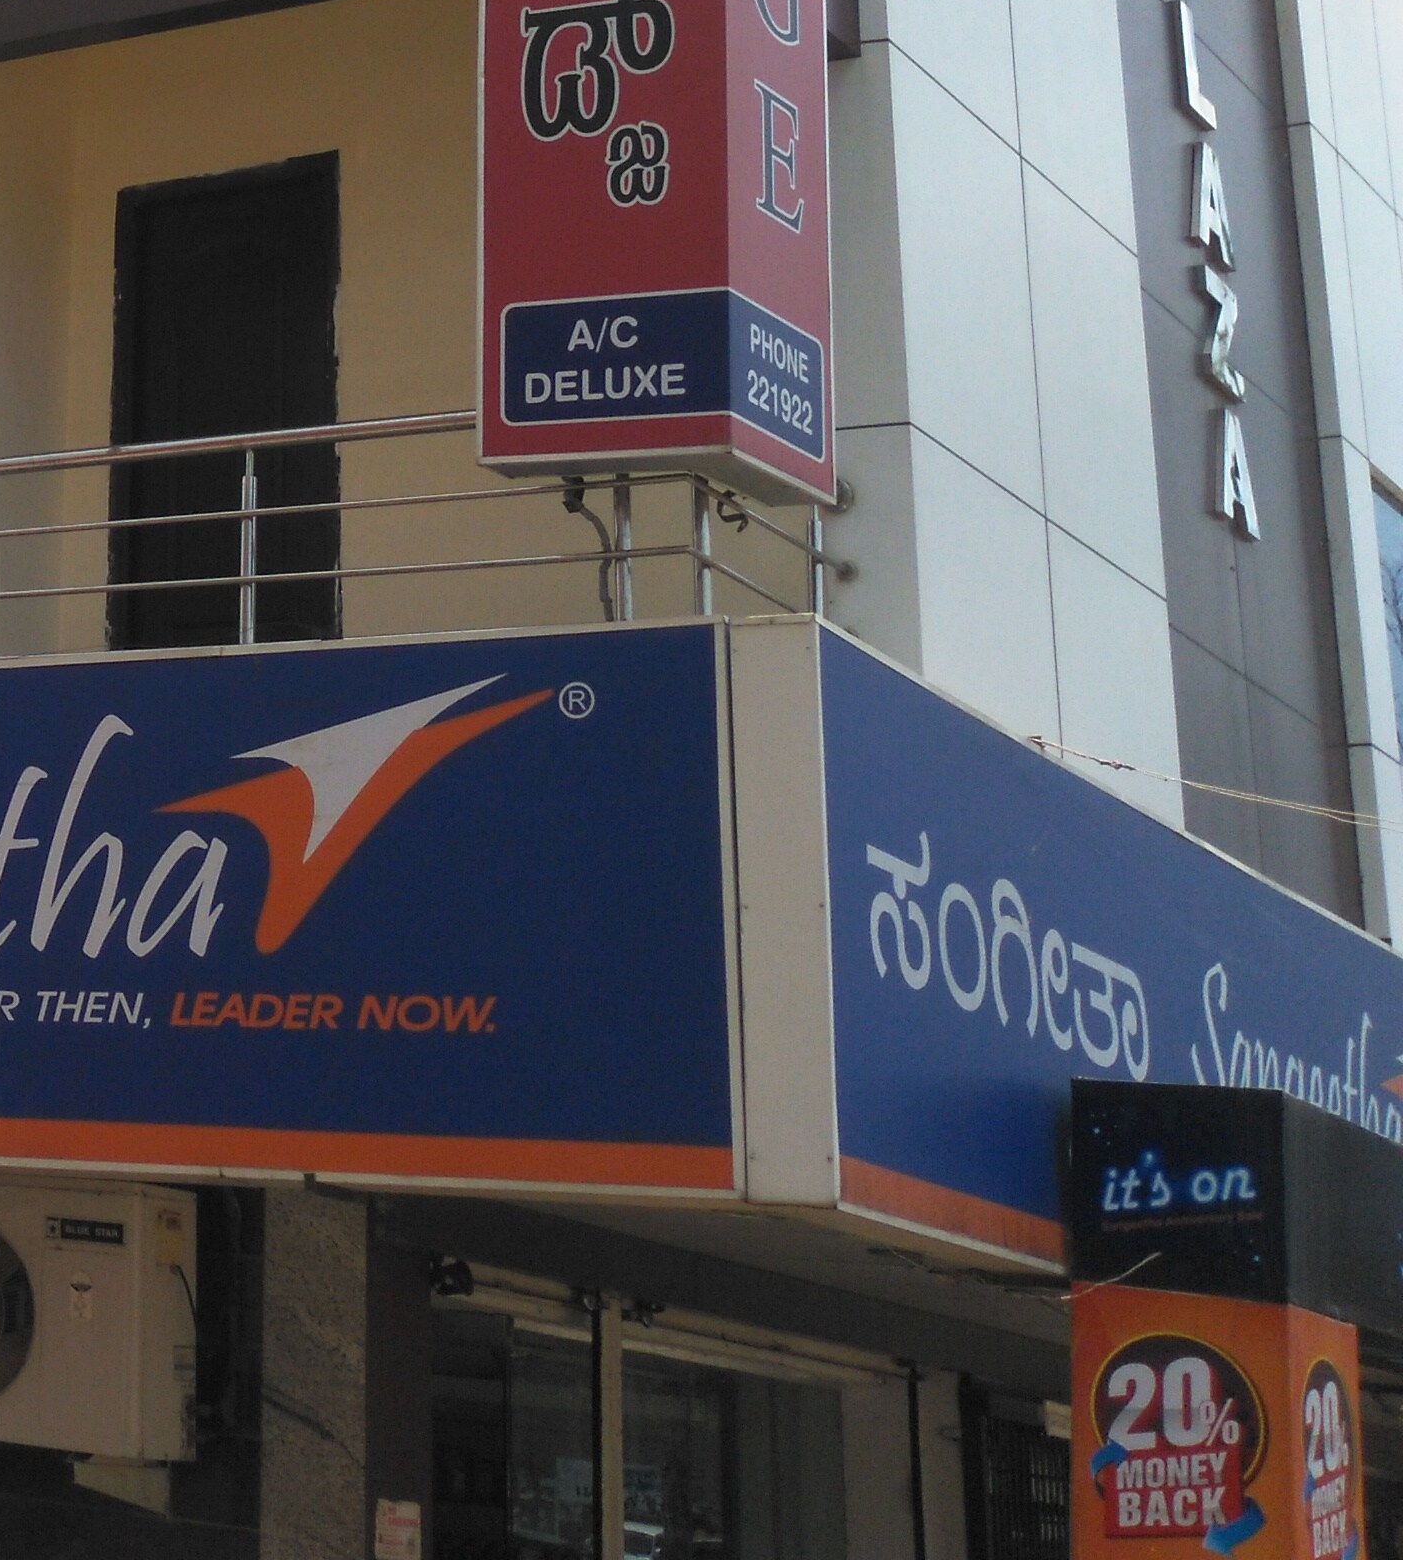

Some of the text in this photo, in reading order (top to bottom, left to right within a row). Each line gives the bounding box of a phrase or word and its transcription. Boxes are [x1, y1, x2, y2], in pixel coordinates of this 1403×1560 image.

[567, 315, 640, 353] A/C
[750, 322, 810, 384] PHONE
[524, 363, 686, 405] DELUXE
[746, 369, 814, 436] 221922
[865, 831, 1150, 1082] ಸಂಗೀತಾ
[35, 990, 152, 1029] THEN,
[168, 991, 339, 1030] LEADER
[355, 994, 498, 1034] NOW.
[1103, 1151, 1257, 1212] it's on
[64, 1225, 119, 1238] BLUE STAR
[1107, 1356, 1241, 1452] 20%
[1116, 1451, 1228, 1491] MONEY
[1118, 1487, 1227, 1528] BACK
